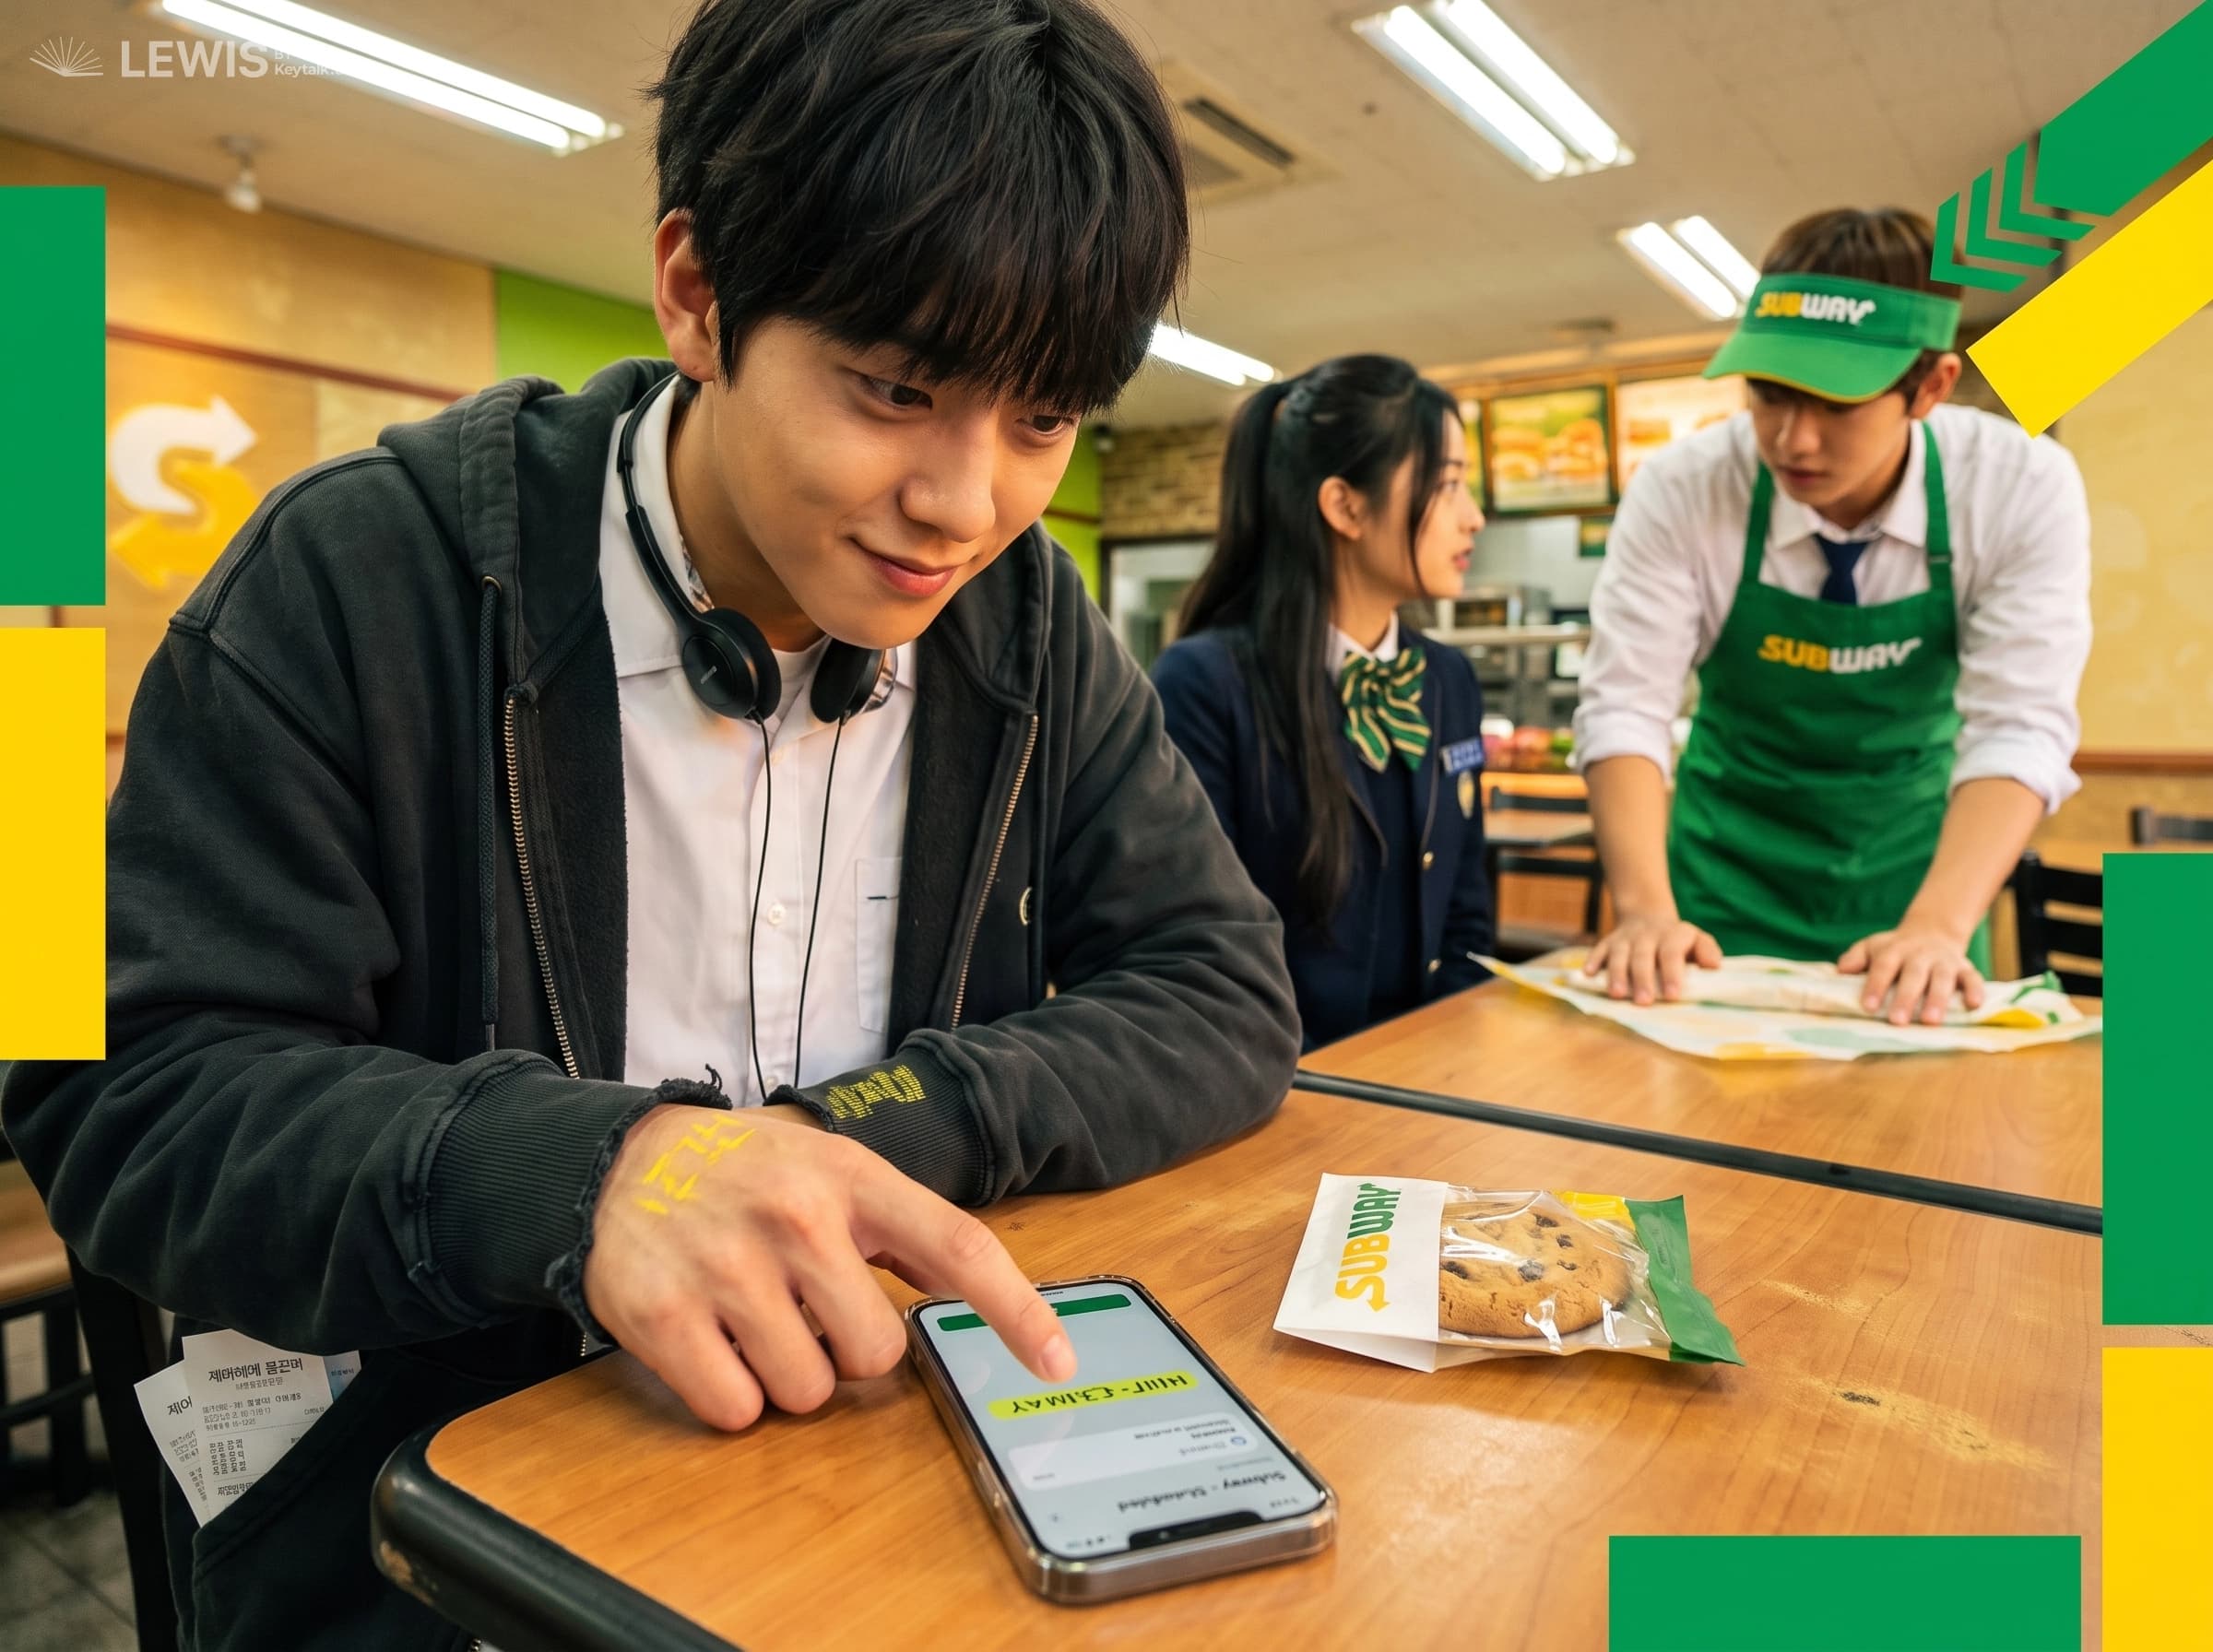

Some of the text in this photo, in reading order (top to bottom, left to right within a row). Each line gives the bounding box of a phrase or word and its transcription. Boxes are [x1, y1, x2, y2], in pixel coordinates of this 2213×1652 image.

[1754, 290, 1876, 326] SUBWAY
[1757, 634, 1923, 675] SUBWAY
[1334, 1182, 1402, 1313] SUBWAY
